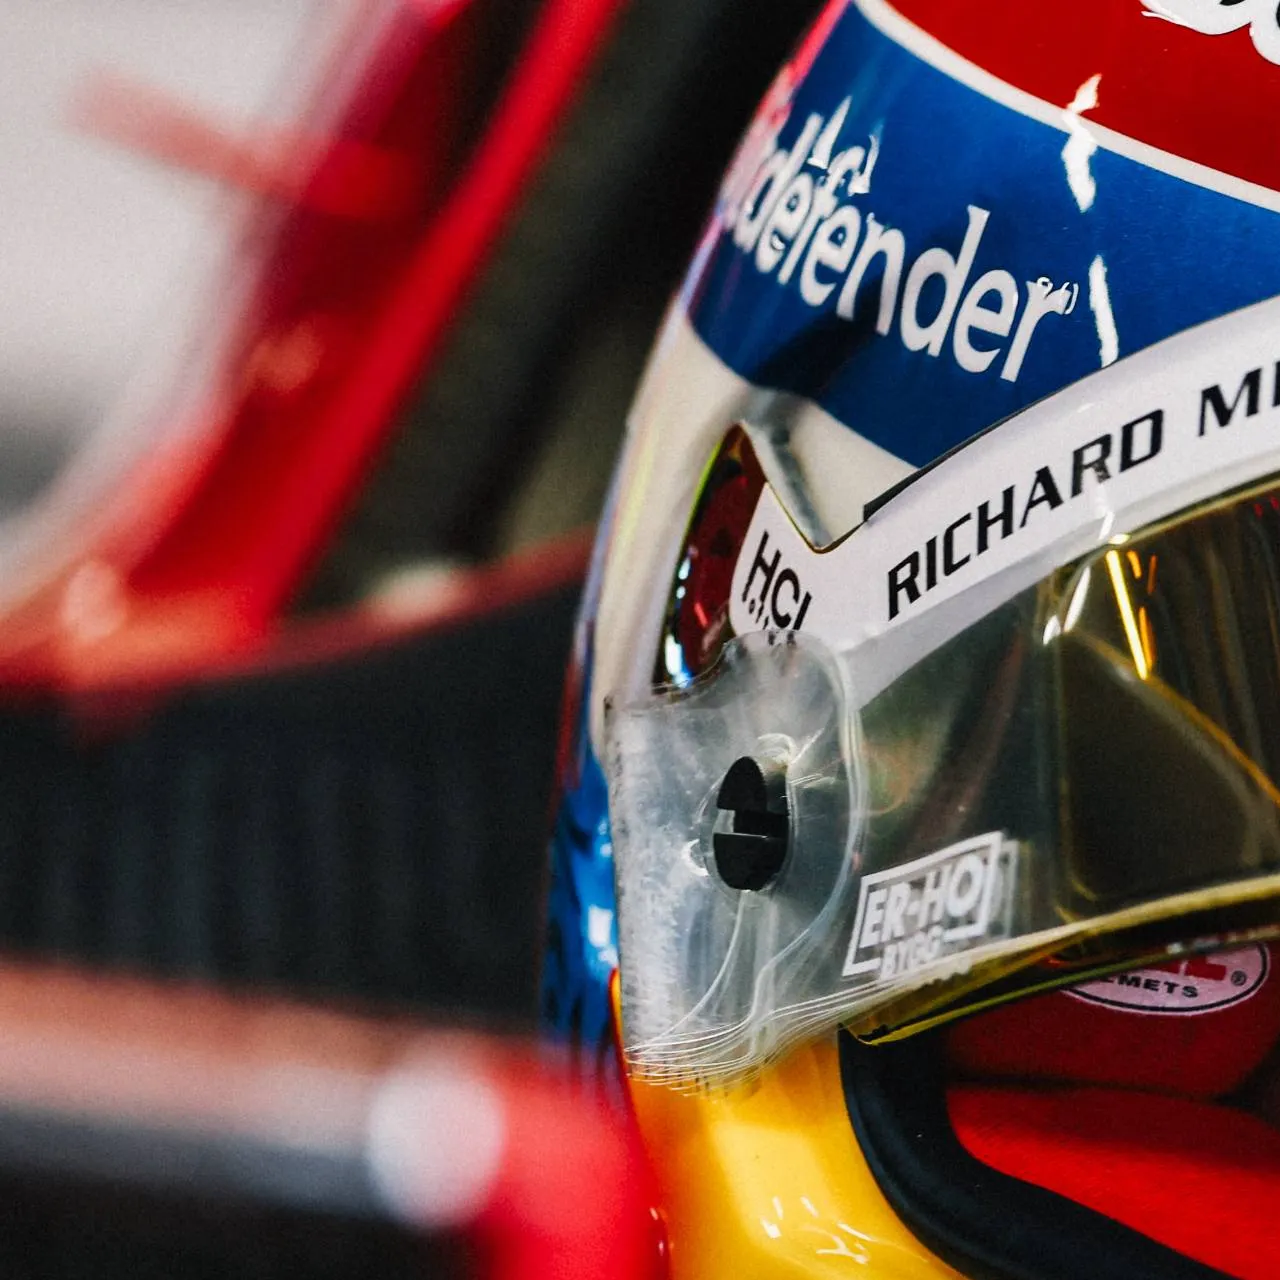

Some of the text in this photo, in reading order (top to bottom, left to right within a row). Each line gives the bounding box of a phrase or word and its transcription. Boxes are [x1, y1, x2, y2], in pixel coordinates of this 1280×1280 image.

[727, 112, 1076, 383] defender
[888, 408, 1164, 622] RICHARD
[1105, 973, 1199, 998] METS
